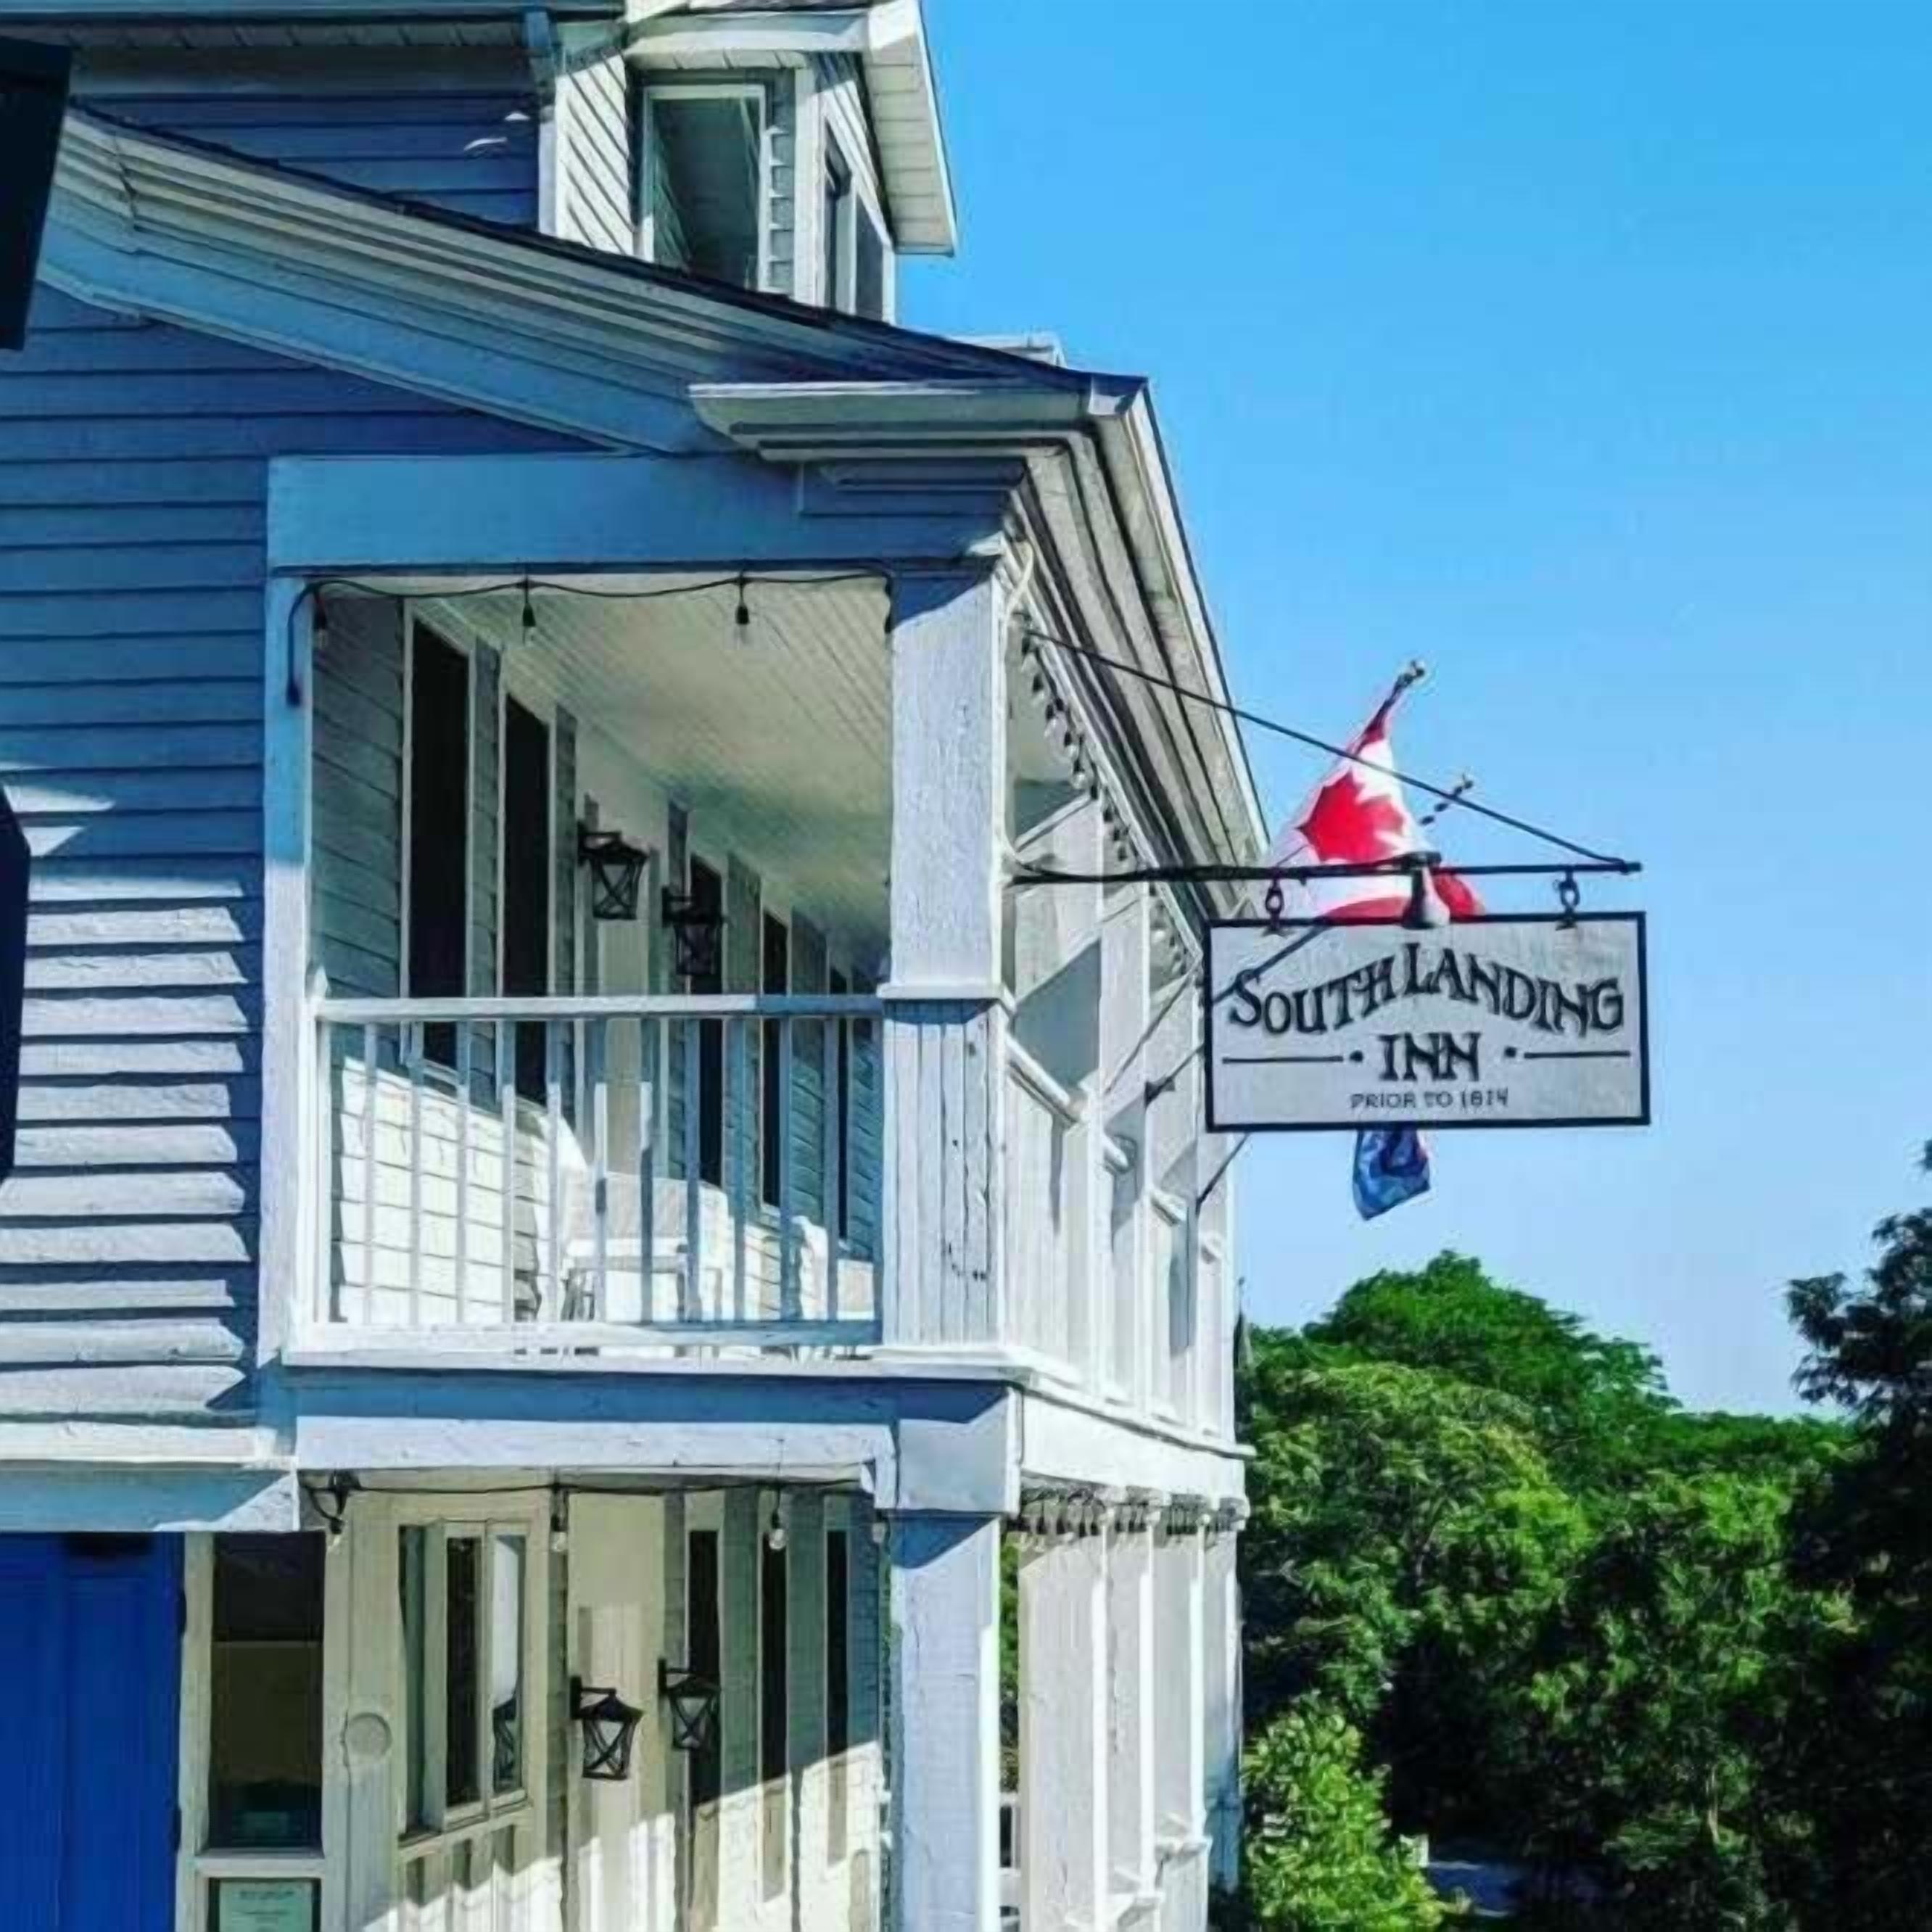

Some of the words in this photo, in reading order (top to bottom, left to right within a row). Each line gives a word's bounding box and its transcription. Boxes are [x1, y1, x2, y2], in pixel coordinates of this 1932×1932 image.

[1230, 955, 1395, 1035] SOUTH
[1403, 942, 1625, 1037] LANDING
[1377, 1032, 1482, 1081] INN
[1350, 1092, 1416, 1109] PRIOR
[1424, 1091, 1453, 1108] TO
